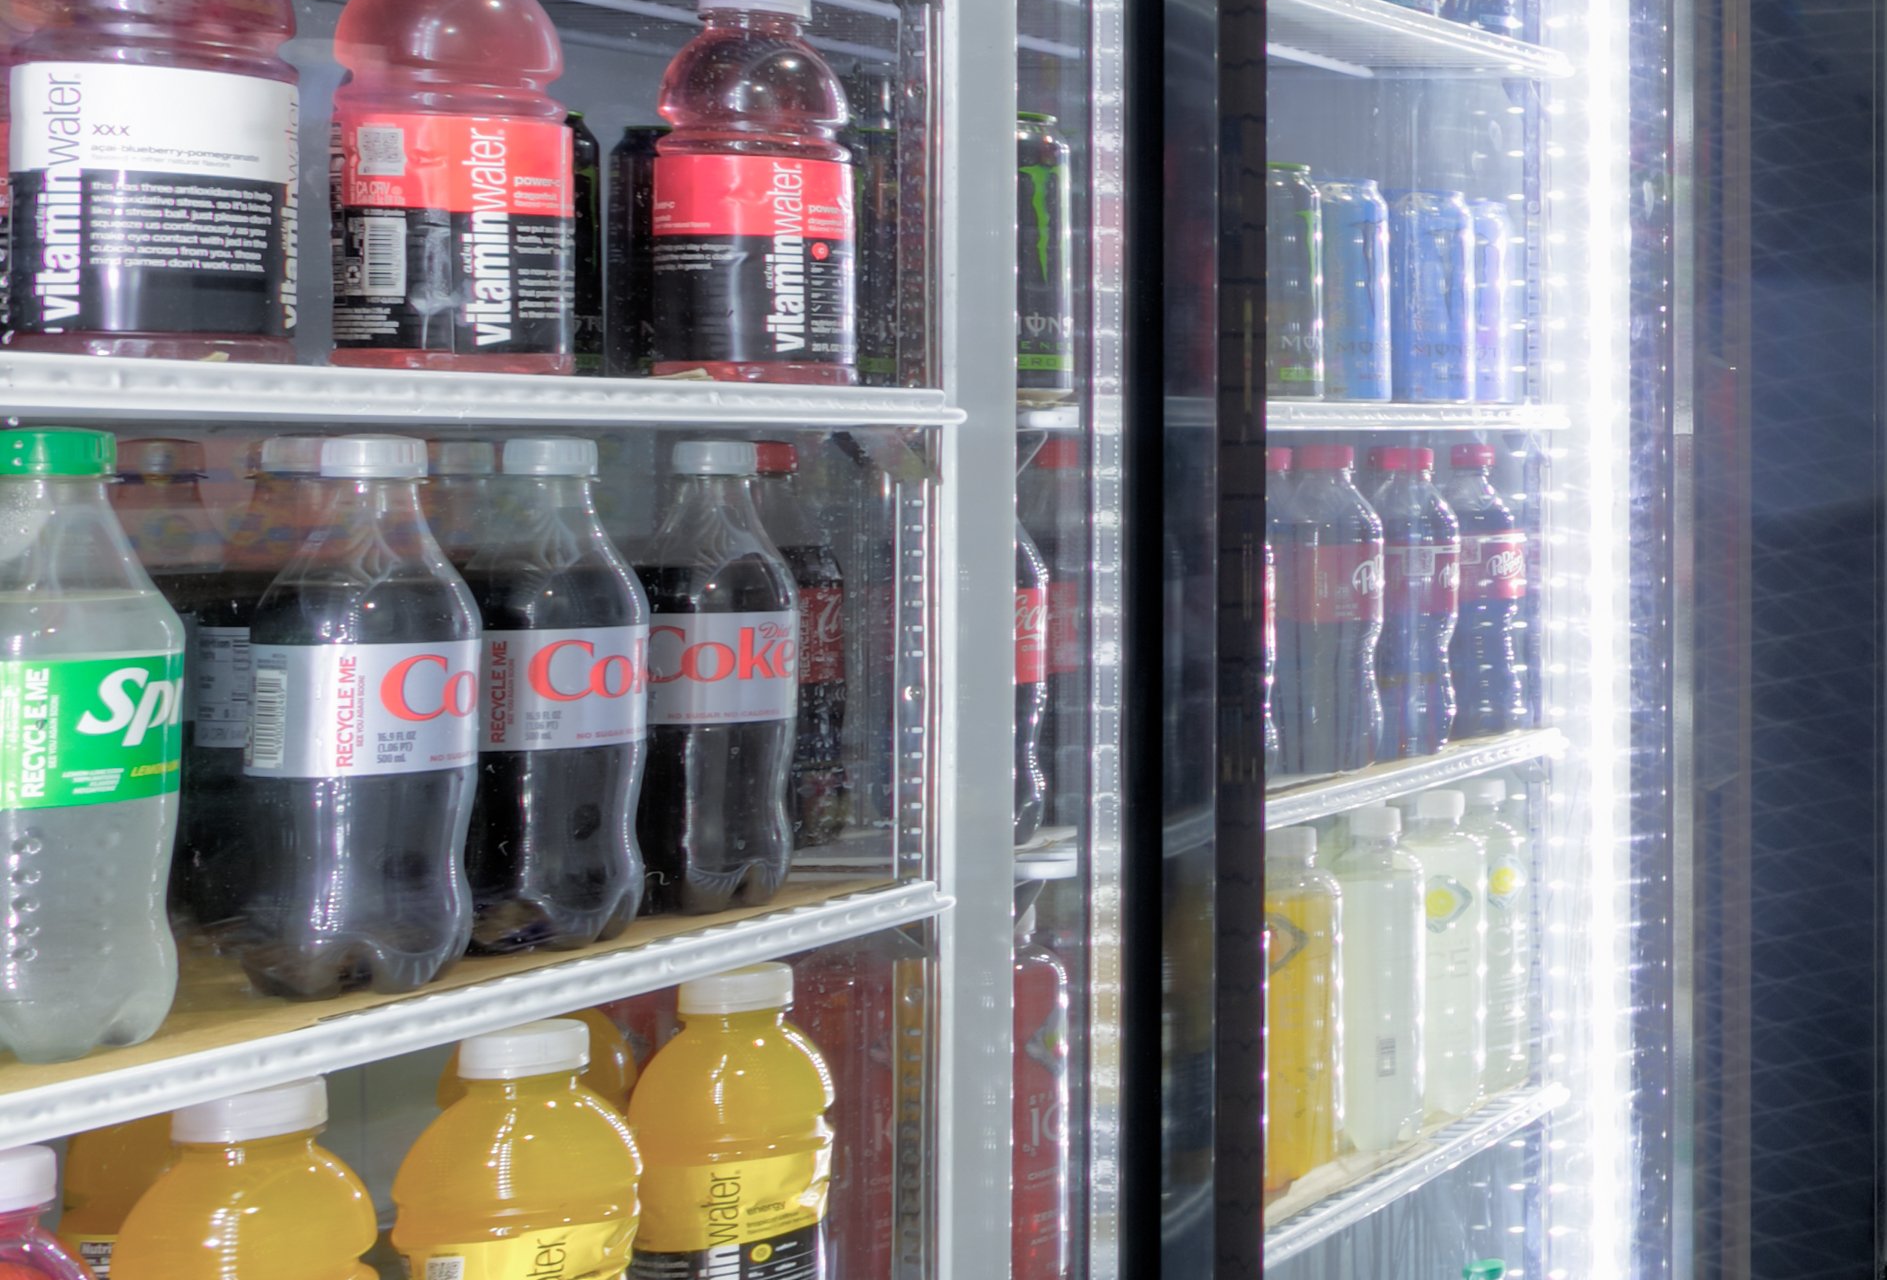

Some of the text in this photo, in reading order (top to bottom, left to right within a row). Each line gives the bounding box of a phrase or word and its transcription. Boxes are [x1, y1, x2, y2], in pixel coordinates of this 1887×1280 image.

[35, 73, 82, 322] vitaminwater
[462, 127, 511, 346] vitaminwater
[766, 162, 805, 352] vitaminwater
[336, 656, 357, 768] RECYCLE ME
[490, 640, 508, 743] RECYCLE ME
[648, 625, 796, 684] Coke
[21, 668, 49, 797] RECYCLE ME
[377, 754, 393, 764] 500
